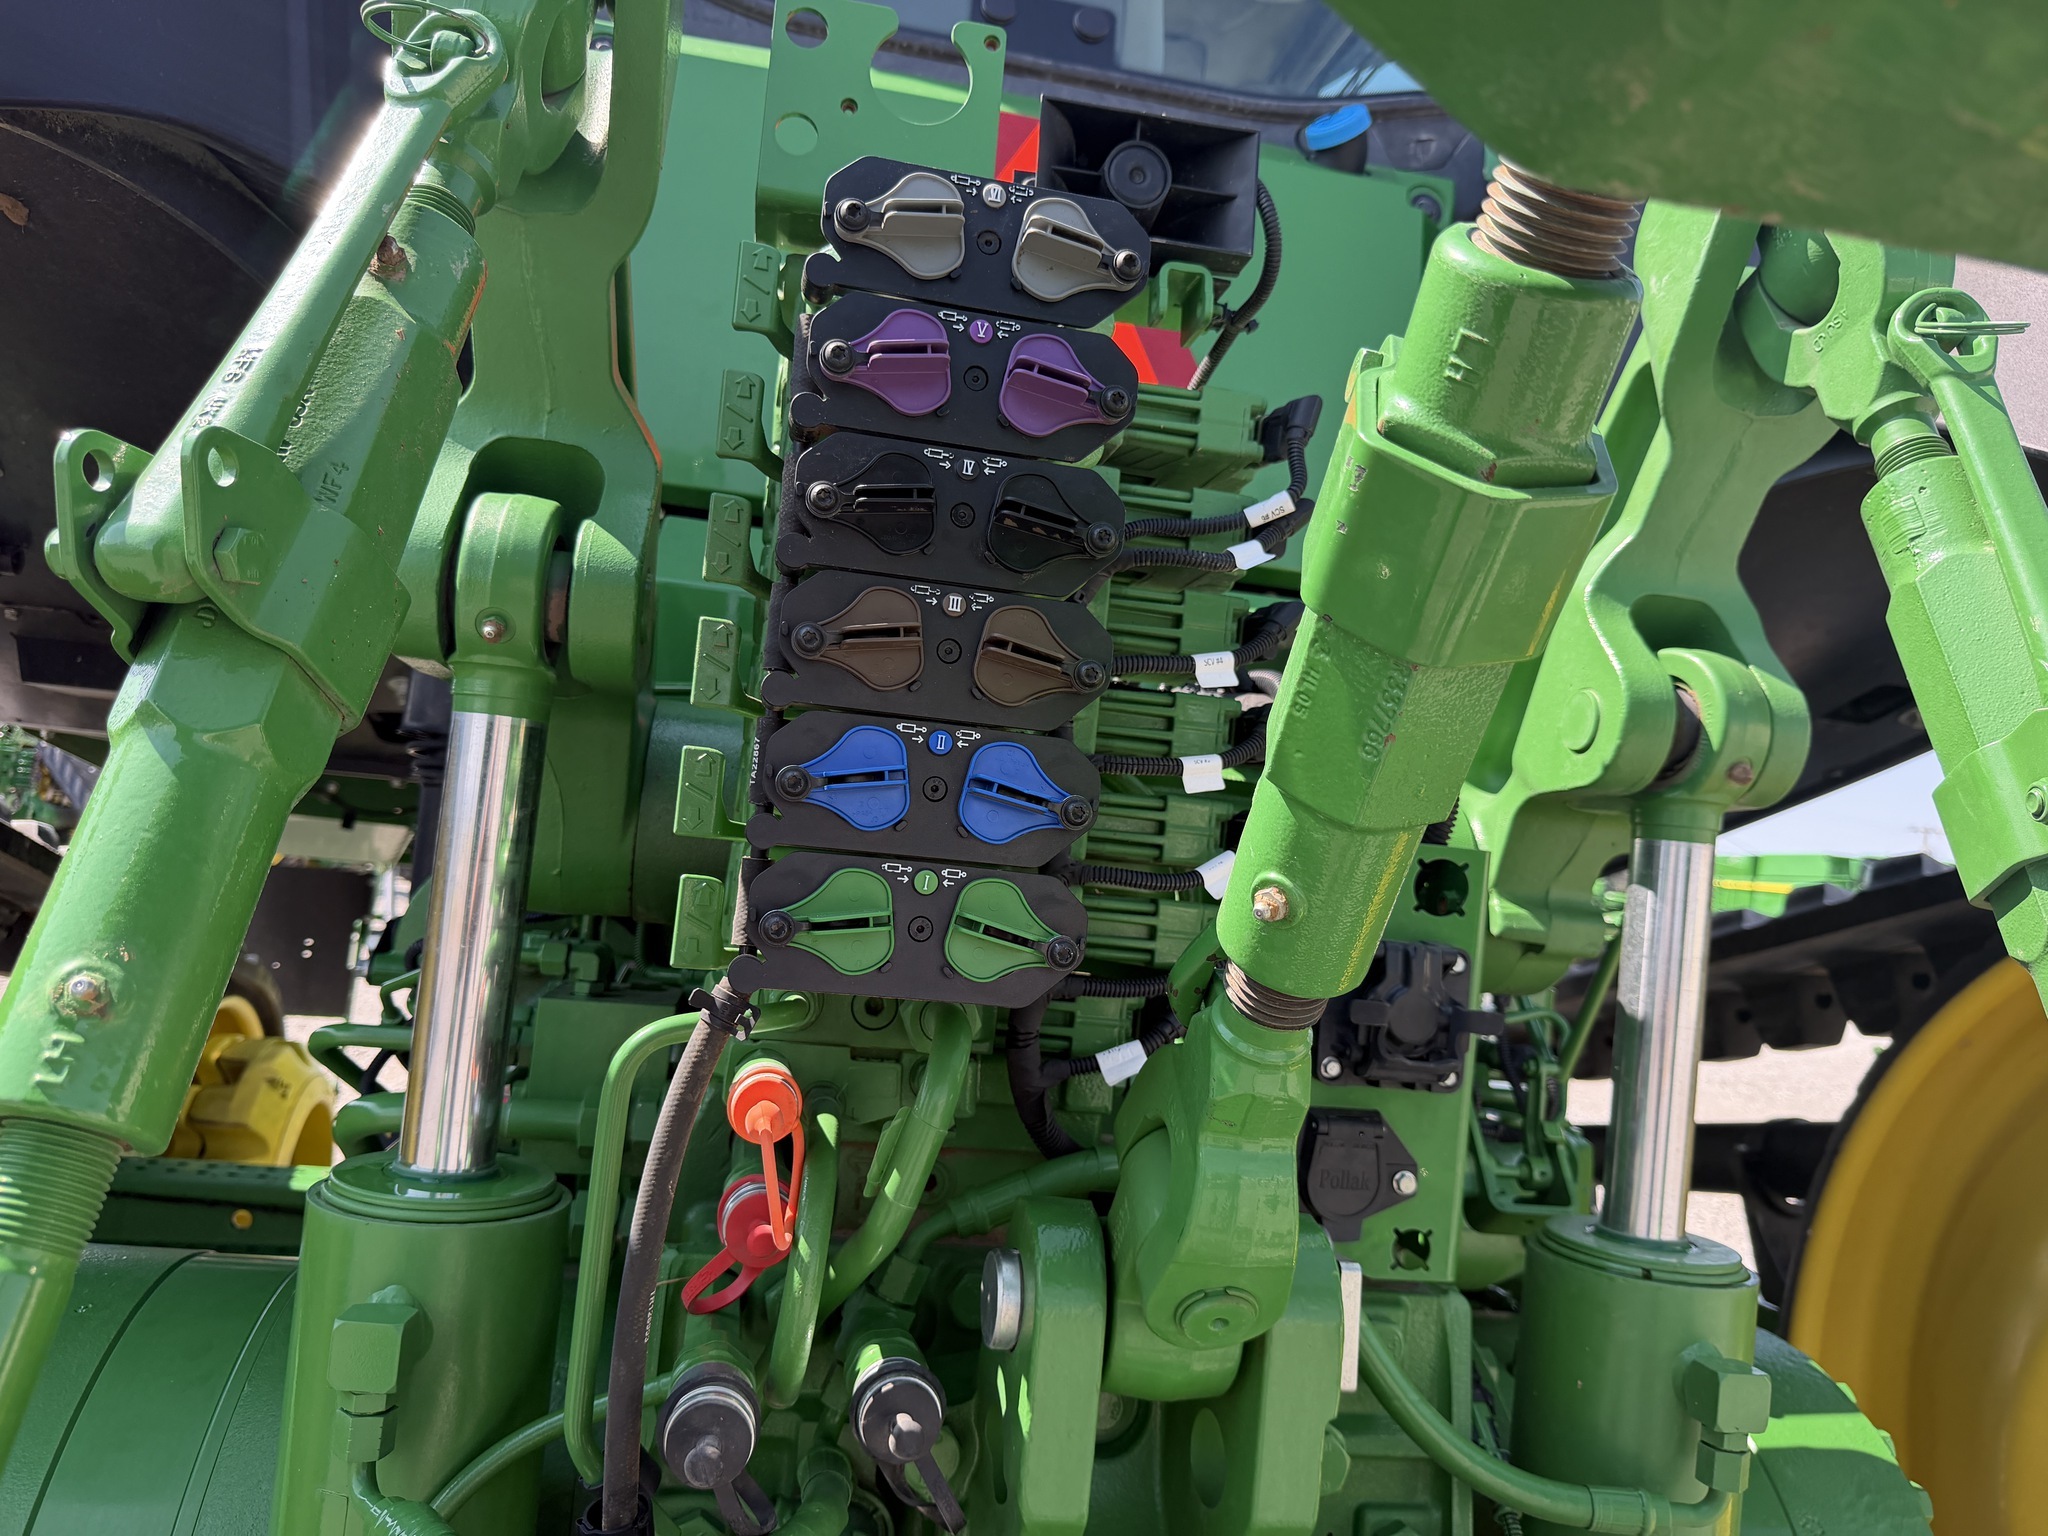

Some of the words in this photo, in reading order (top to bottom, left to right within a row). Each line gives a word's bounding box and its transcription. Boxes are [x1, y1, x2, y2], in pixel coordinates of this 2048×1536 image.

[977, 321, 989, 338] V
[962, 458, 976, 476] IV
[1271, 505, 1286, 520] SCV
[947, 595, 963, 612] III
[936, 734, 946, 750] II
[750, 736, 761, 786] TA22867
[922, 874, 931, 891] I
[1319, 1167, 1371, 1192] Pollak
